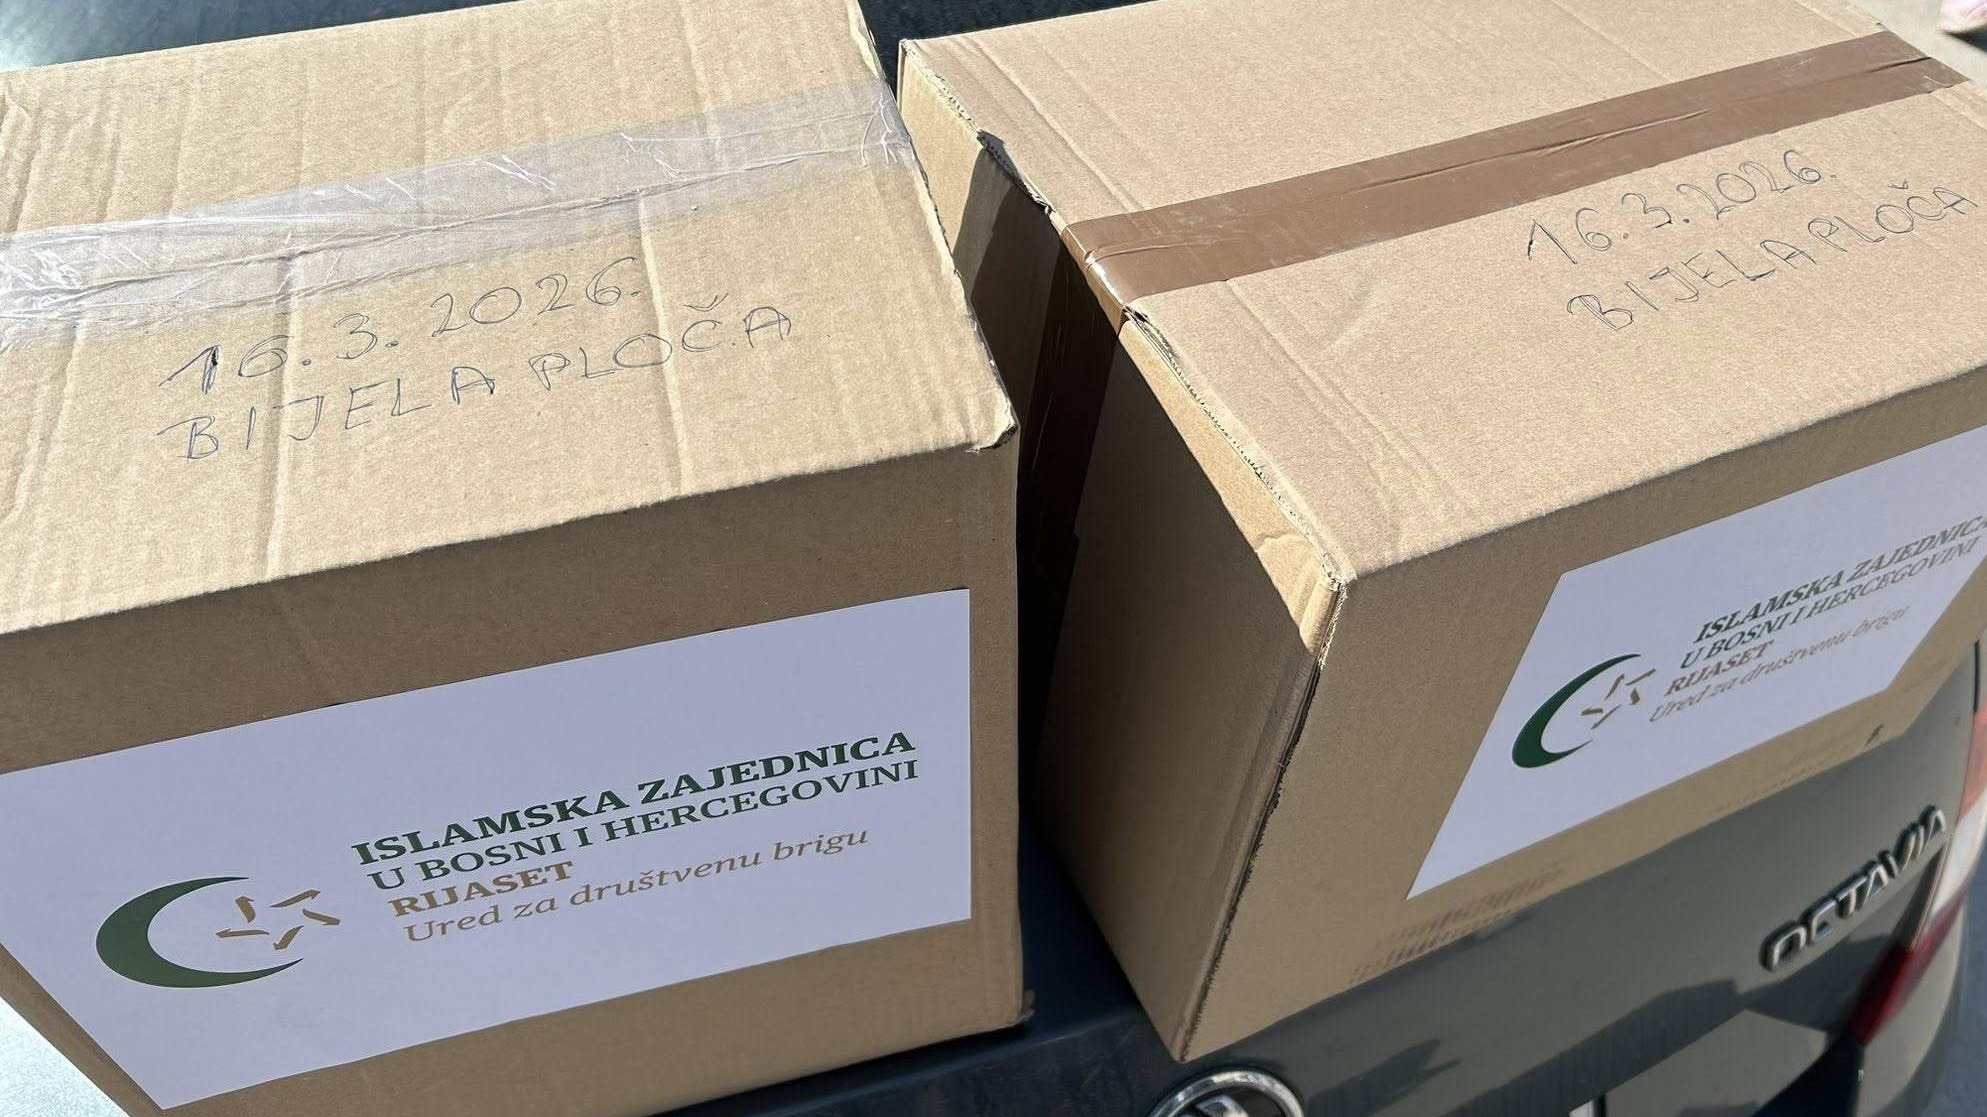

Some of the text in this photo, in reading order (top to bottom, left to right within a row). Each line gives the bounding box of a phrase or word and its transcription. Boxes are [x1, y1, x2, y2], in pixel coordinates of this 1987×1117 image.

[1567, 180, 1978, 331] BIJELA PLOČA
[157, 367, 496, 460] BIJELA
[1680, 535, 1981, 669] U BOSNI I HERCEGOVINI
[1693, 569, 1845, 643] ISLAMSKA
[1649, 684, 1711, 722] Ured
[1663, 639, 1775, 696] RIJASET
[351, 731, 916, 865] ISLAMSKA ZAJEDNICA
[367, 759, 920, 890] U BOSNI I HERCEGOVINI
[388, 860, 574, 917] RIJASET
[404, 826, 869, 942] Ured za društvenu brigu
[1758, 804, 1947, 972] OCTAVIA
